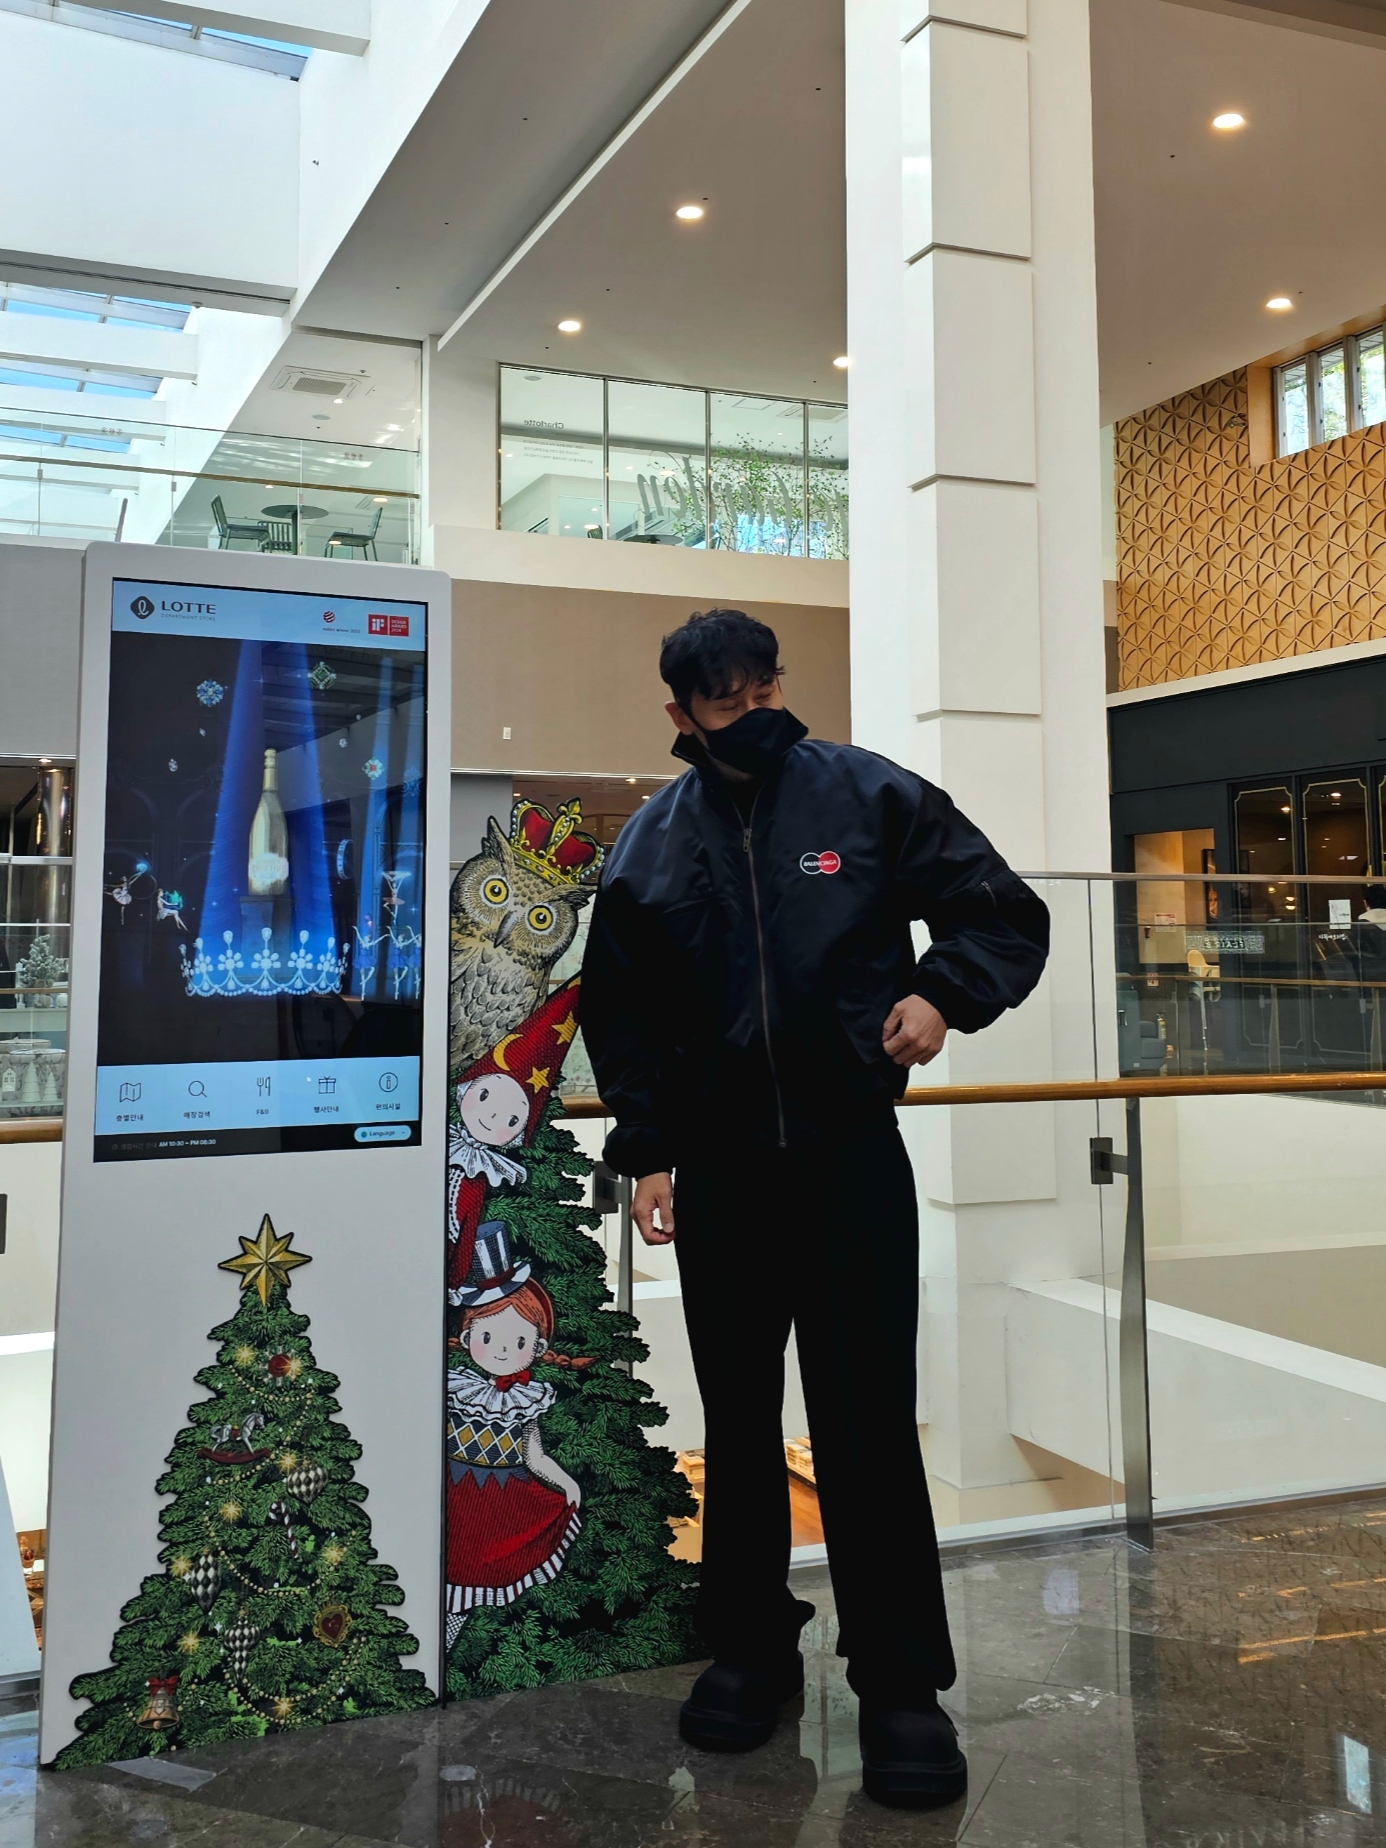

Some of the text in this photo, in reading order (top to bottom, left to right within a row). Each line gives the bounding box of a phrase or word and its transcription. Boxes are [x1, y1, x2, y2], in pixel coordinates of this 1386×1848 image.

[161, 600, 217, 615] LOTTE
[313, 1105, 339, 1114] 행사안내
[376, 1102, 401, 1111] 편의시설
[116, 1113, 144, 1122] 층별안내
[369, 1130, 396, 1138] Language
